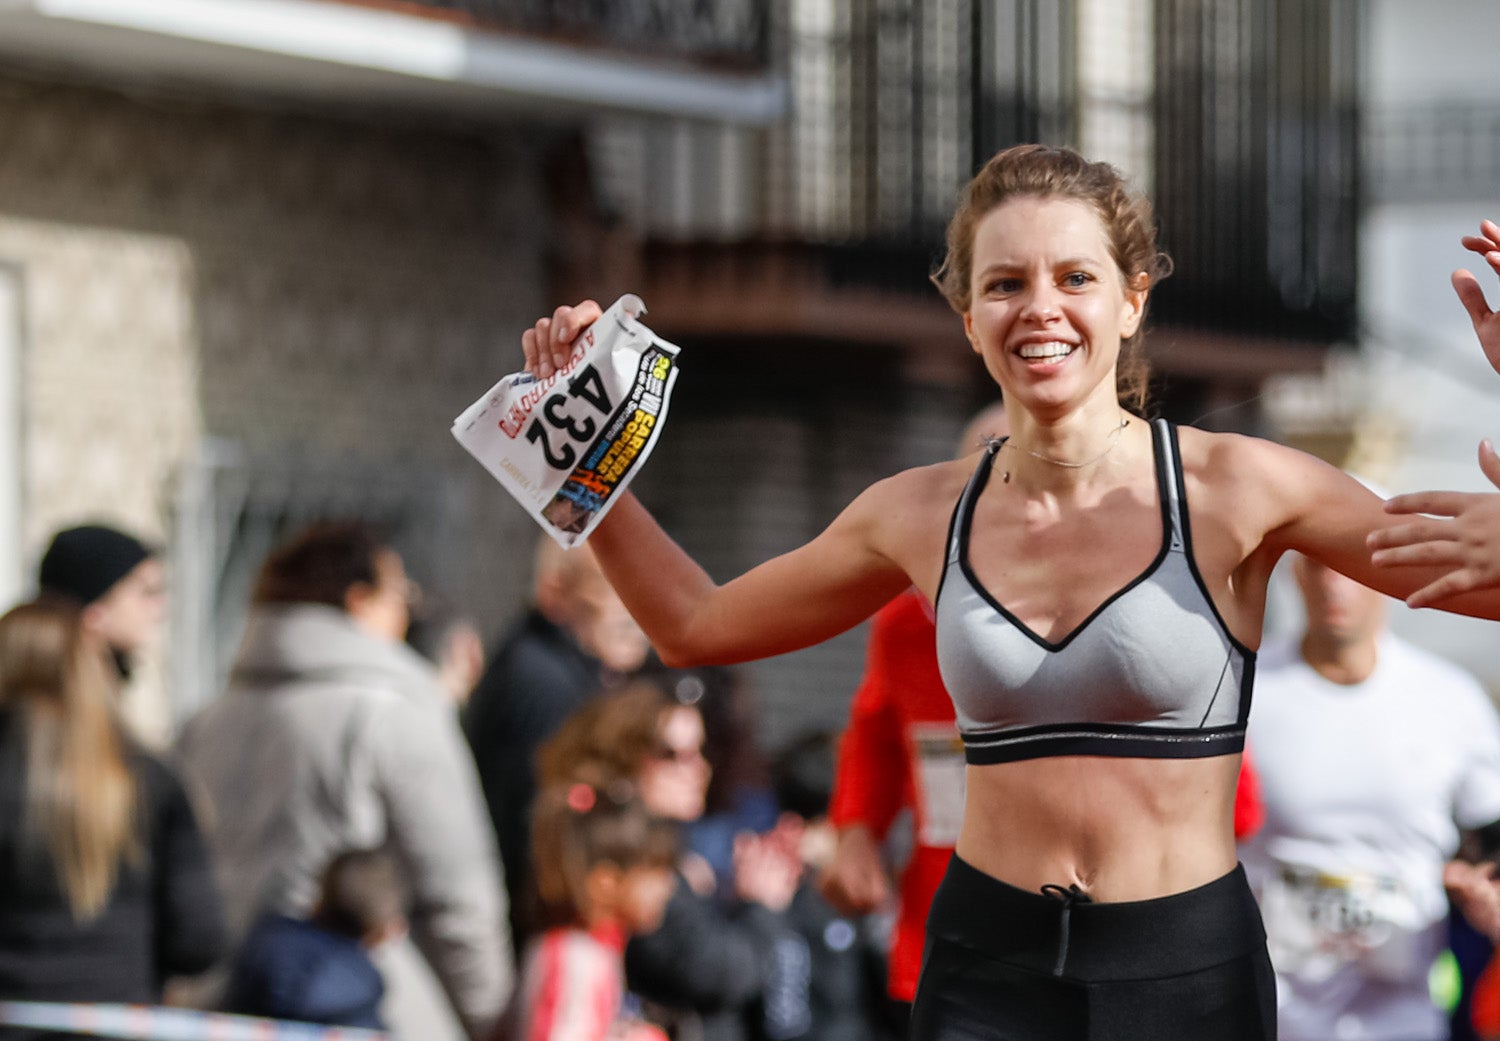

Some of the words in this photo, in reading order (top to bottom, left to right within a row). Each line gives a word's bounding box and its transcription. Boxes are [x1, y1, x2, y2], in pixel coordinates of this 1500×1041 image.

[585, 330, 595, 347] A
[652, 355, 671, 381] 26
[525, 363, 614, 471] 432
[596, 409, 646, 475] POPULAR
[603, 412, 656, 483] CARRERA
